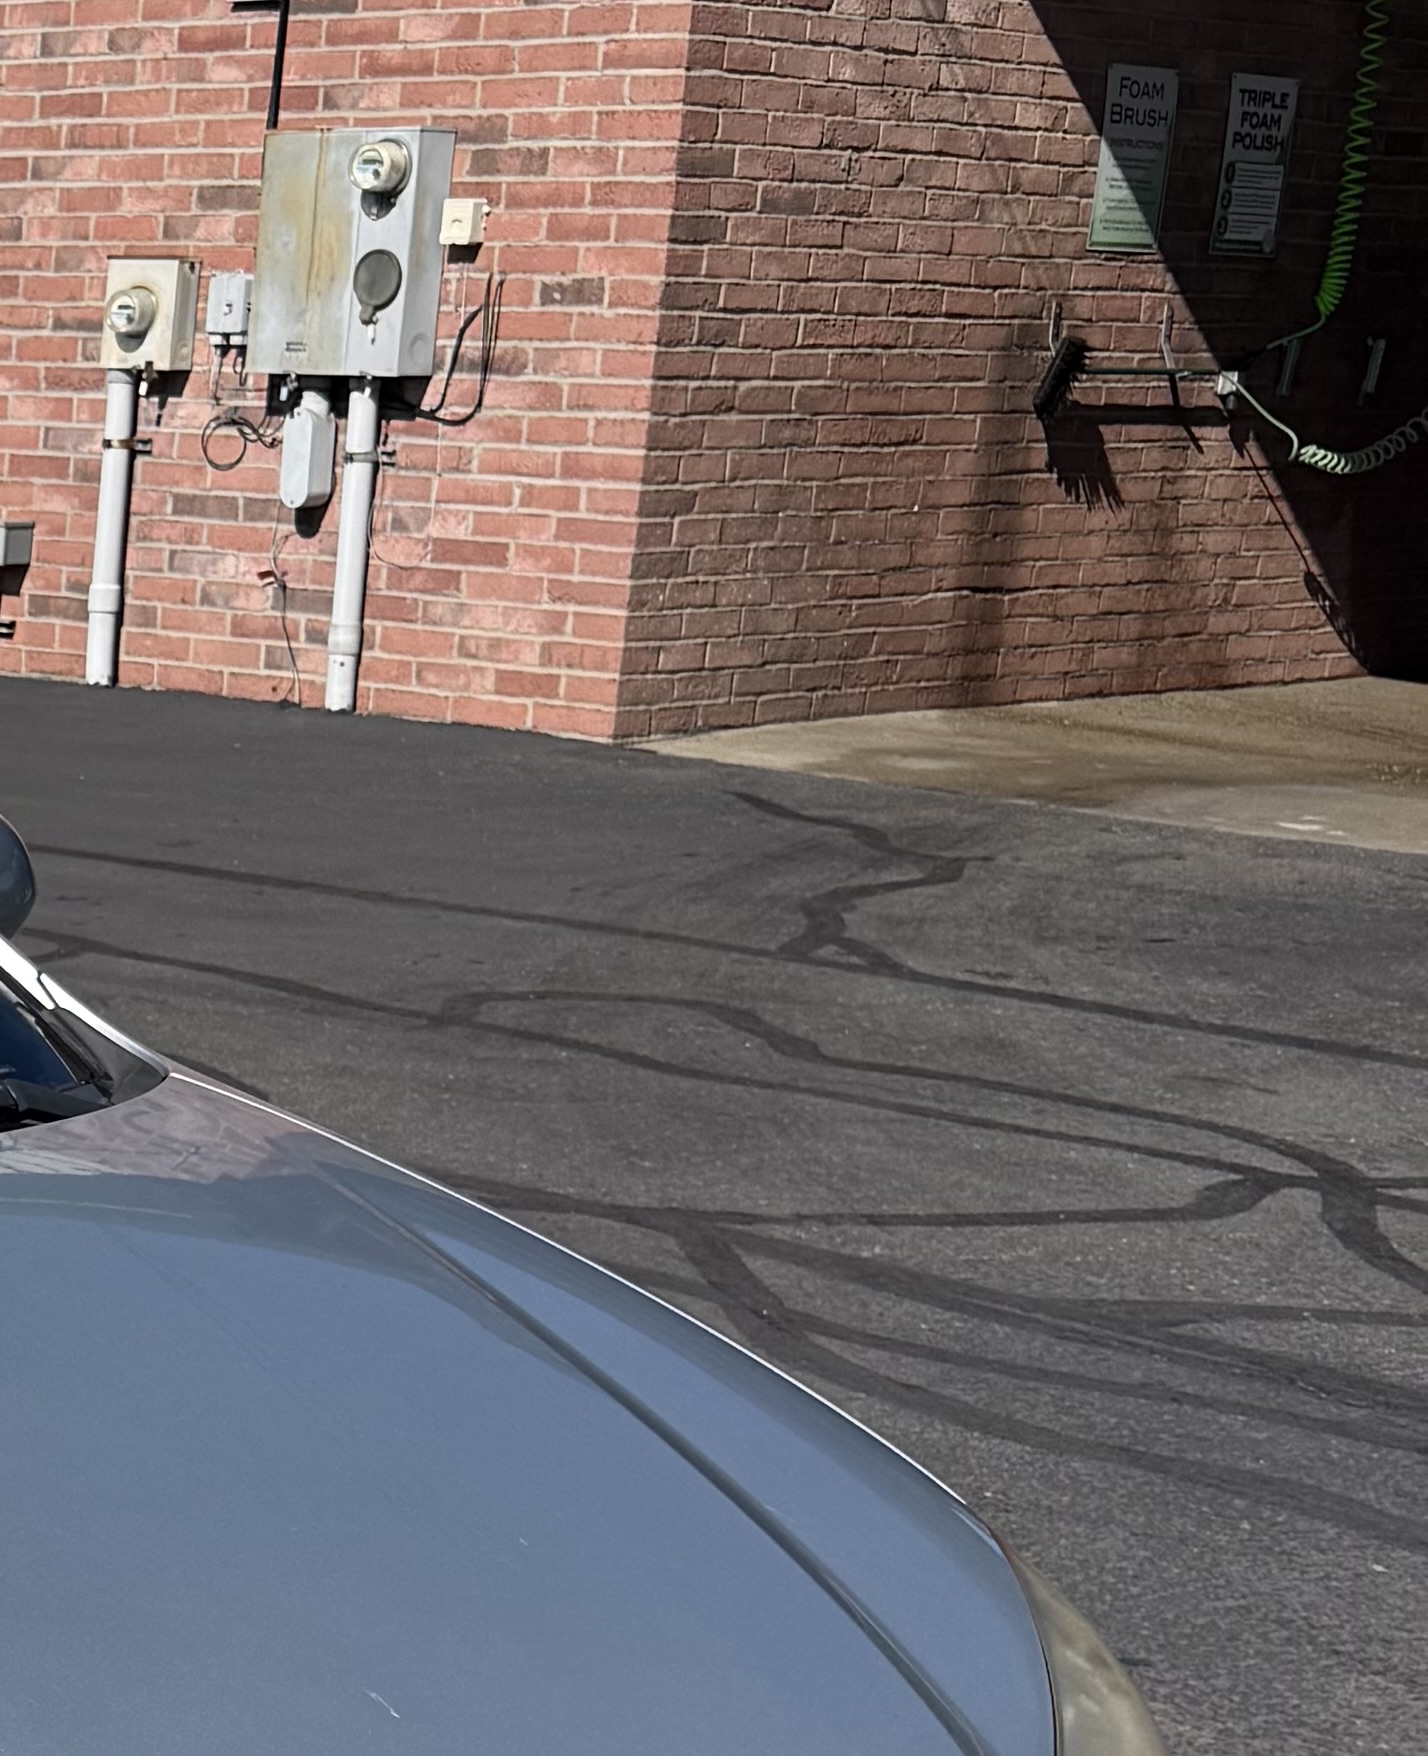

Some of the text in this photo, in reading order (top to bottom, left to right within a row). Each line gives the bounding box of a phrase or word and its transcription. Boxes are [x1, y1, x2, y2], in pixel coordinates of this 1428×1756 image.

[1119, 76, 1165, 100] FOAM
[1239, 87, 1290, 110] TRIPLE
[1110, 103, 1169, 127] BRUSH
[1240, 111, 1282, 132] FOAM
[1232, 131, 1285, 152] POLISH
